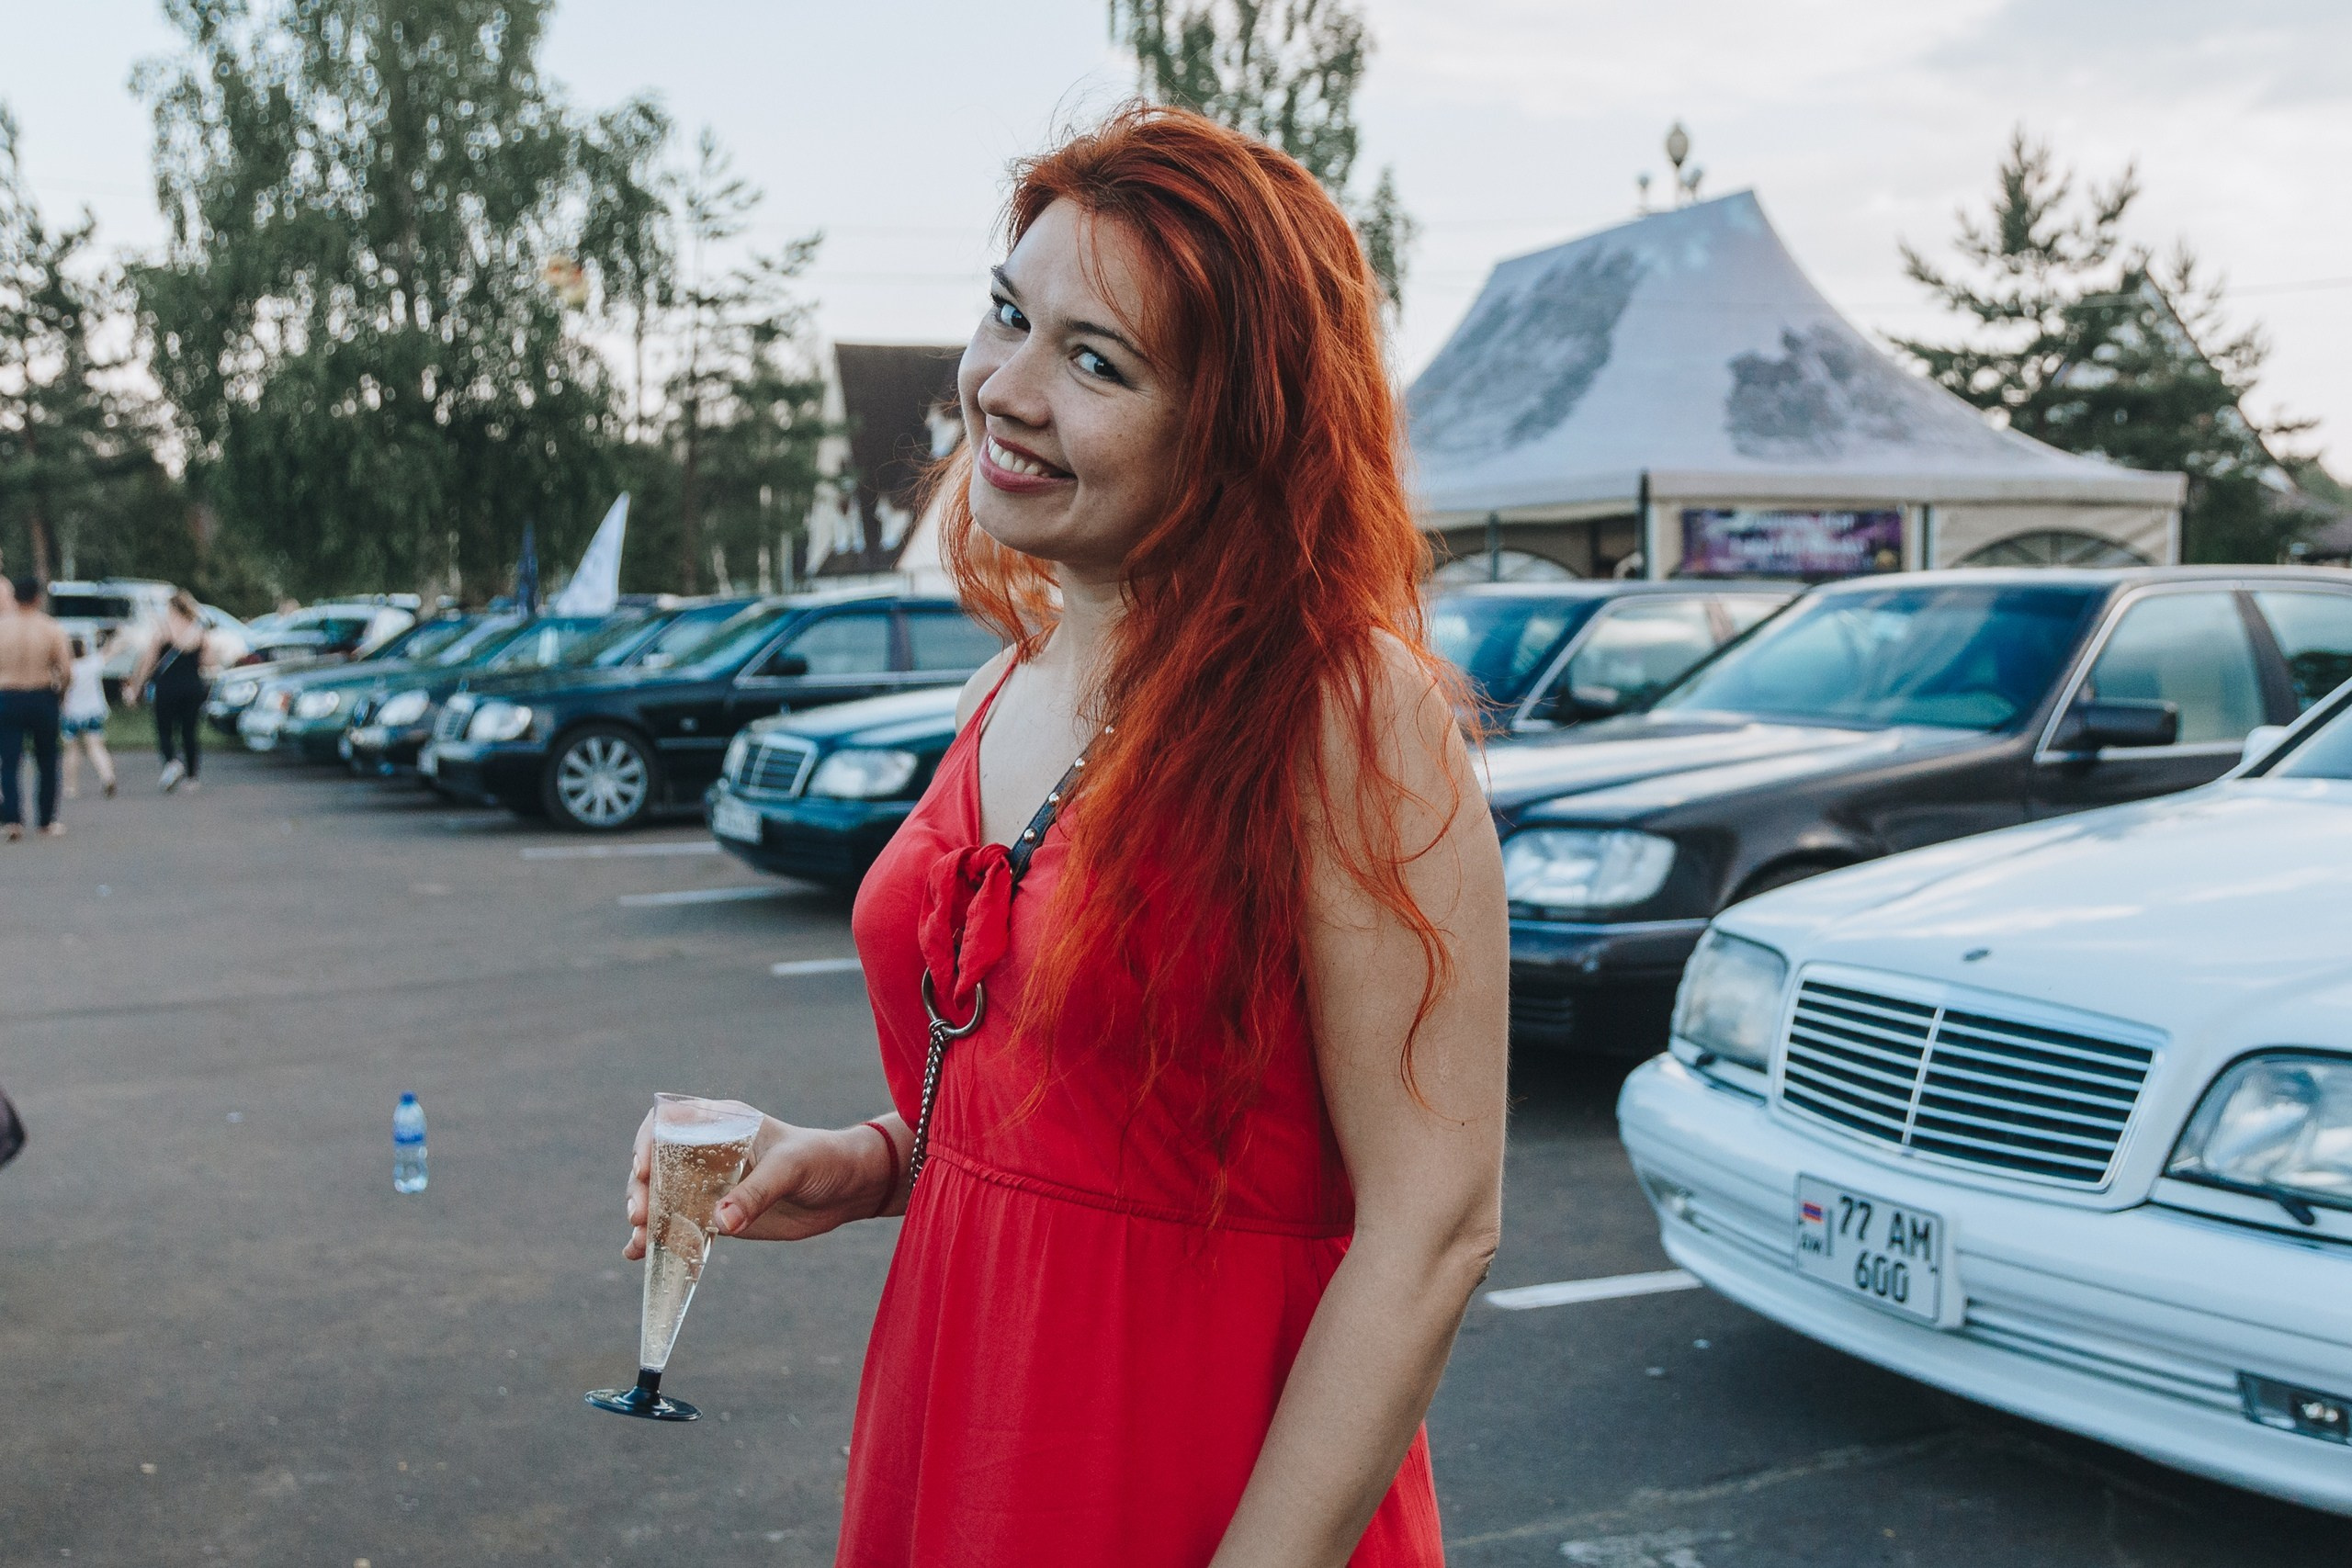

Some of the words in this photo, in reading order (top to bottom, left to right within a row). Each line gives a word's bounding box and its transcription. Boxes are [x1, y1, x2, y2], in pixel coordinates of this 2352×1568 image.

[1839, 1194, 1872, 1241] 77
[1887, 1211, 1930, 1261] AM
[1855, 1250, 1908, 1303] 600
